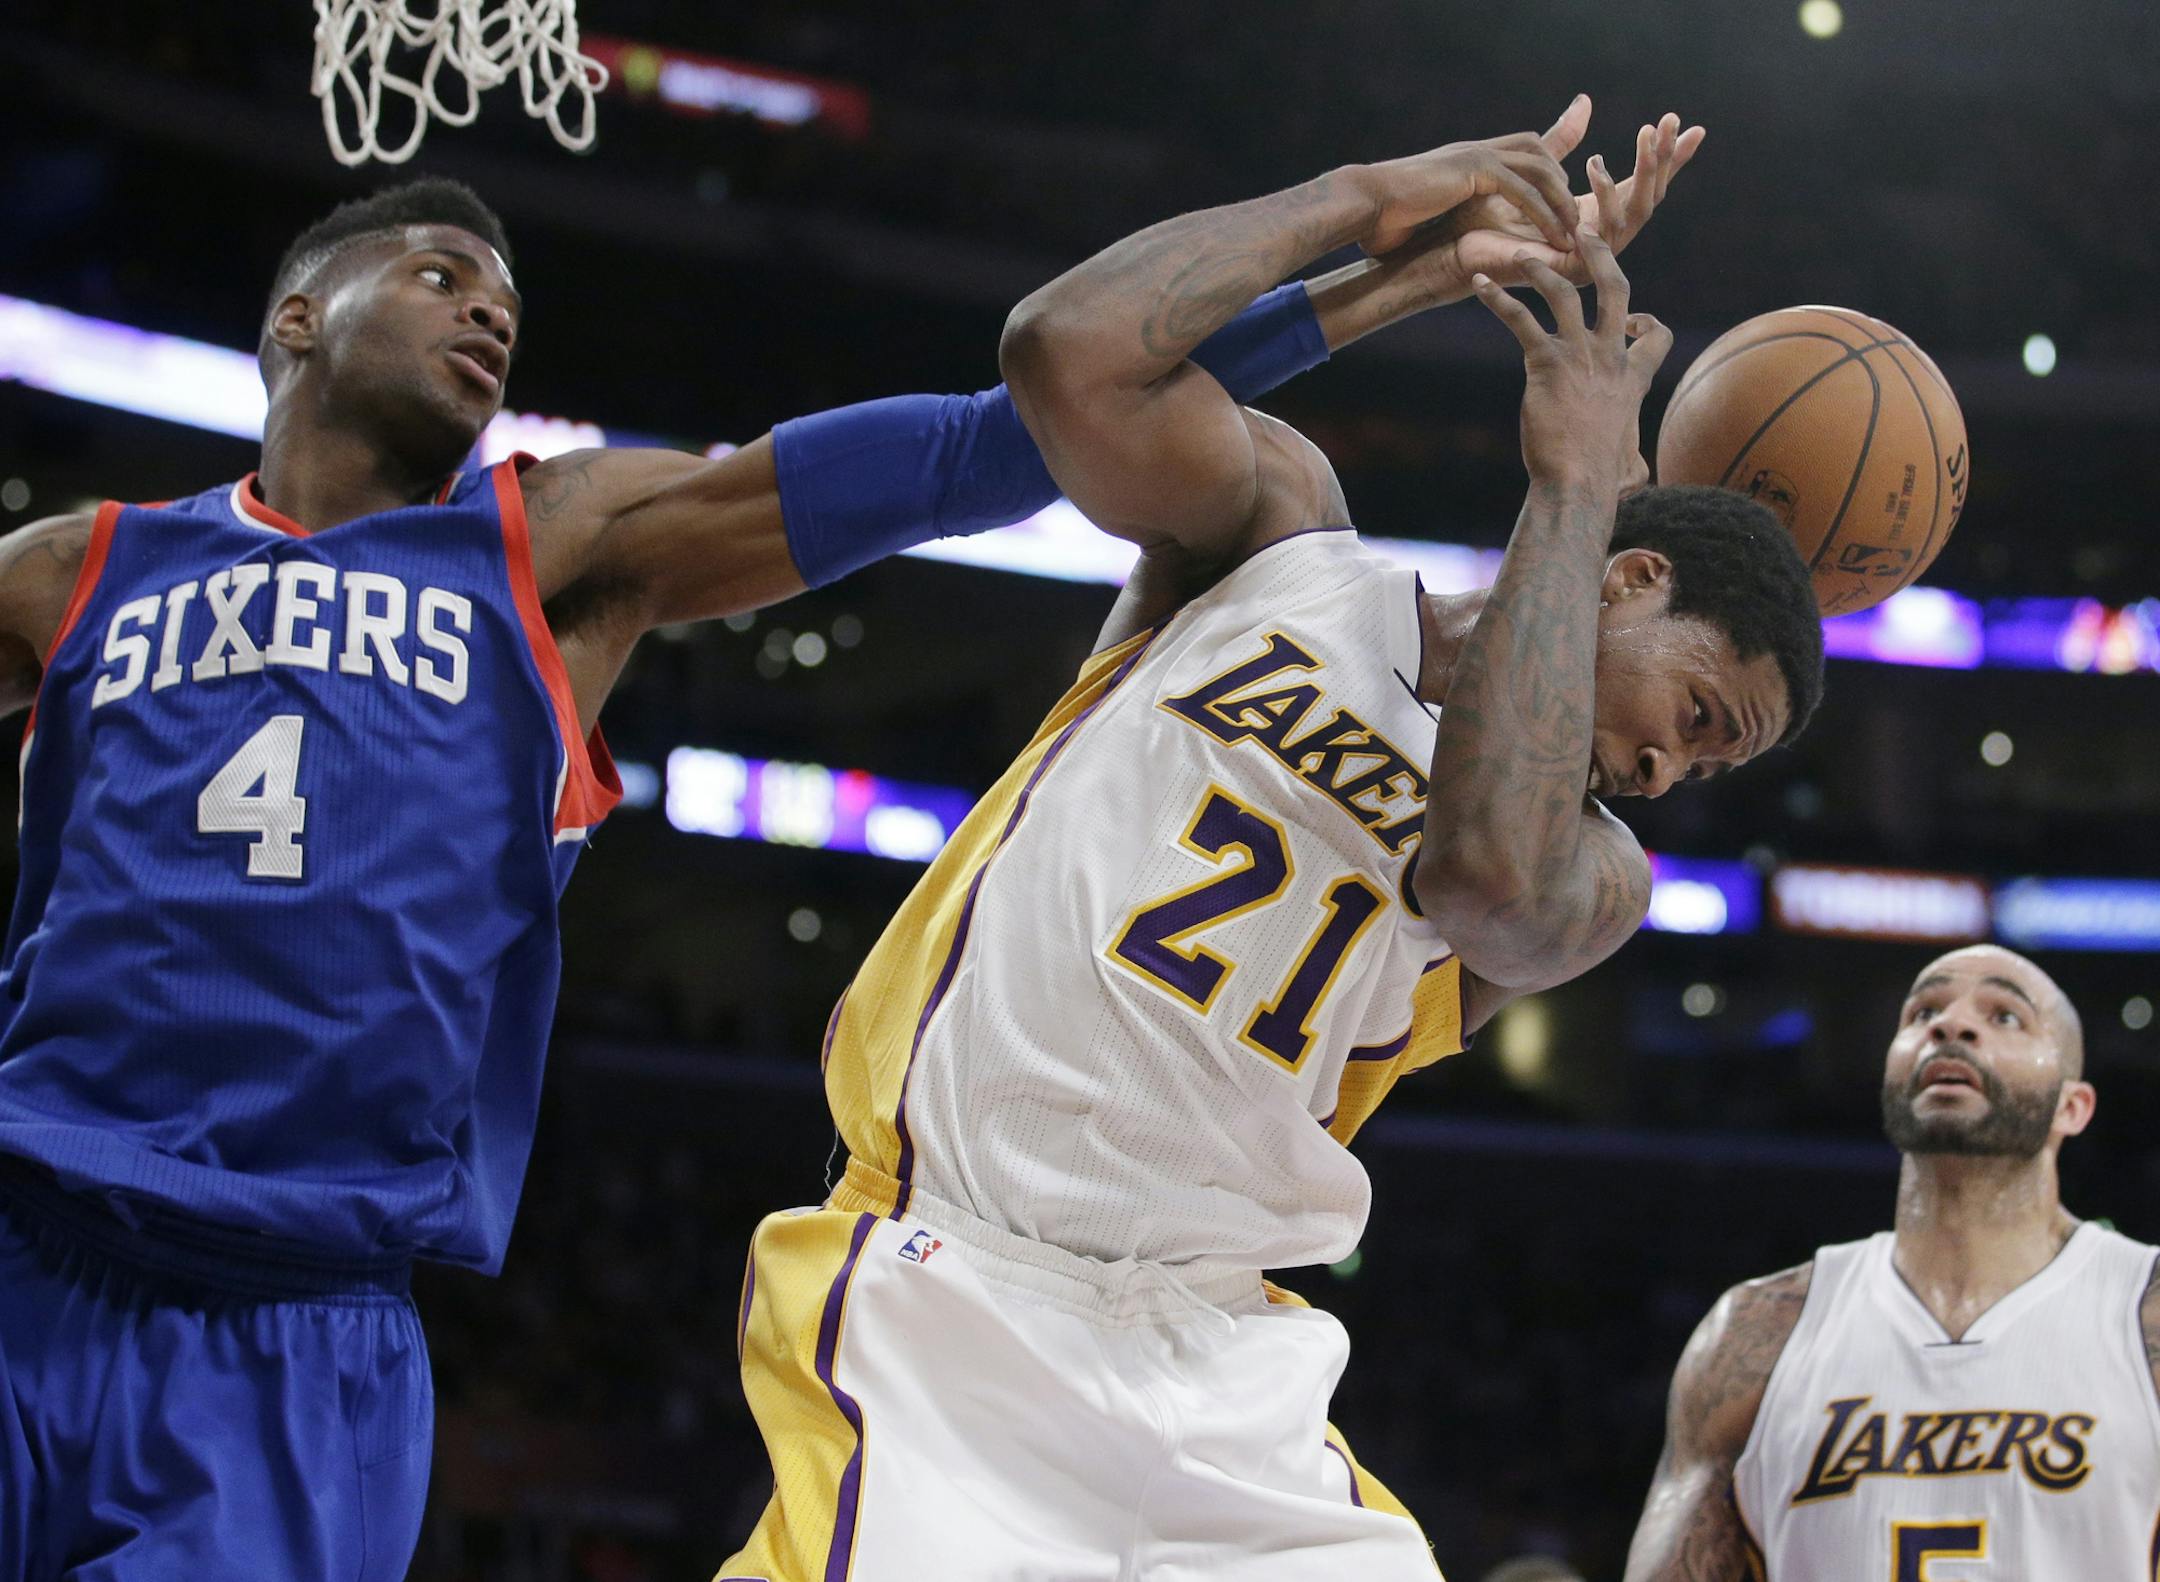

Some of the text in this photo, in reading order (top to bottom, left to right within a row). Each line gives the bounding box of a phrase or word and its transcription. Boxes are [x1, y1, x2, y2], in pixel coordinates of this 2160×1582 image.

[92, 561, 472, 709] SIXERS
[197, 714, 305, 878] 4
[1155, 632, 1430, 920] LAKE
[1104, 782, 1391, 1077] 21
[900, 1249, 919, 1260] NBA
[1791, 1394, 2096, 1508] LAKERS
